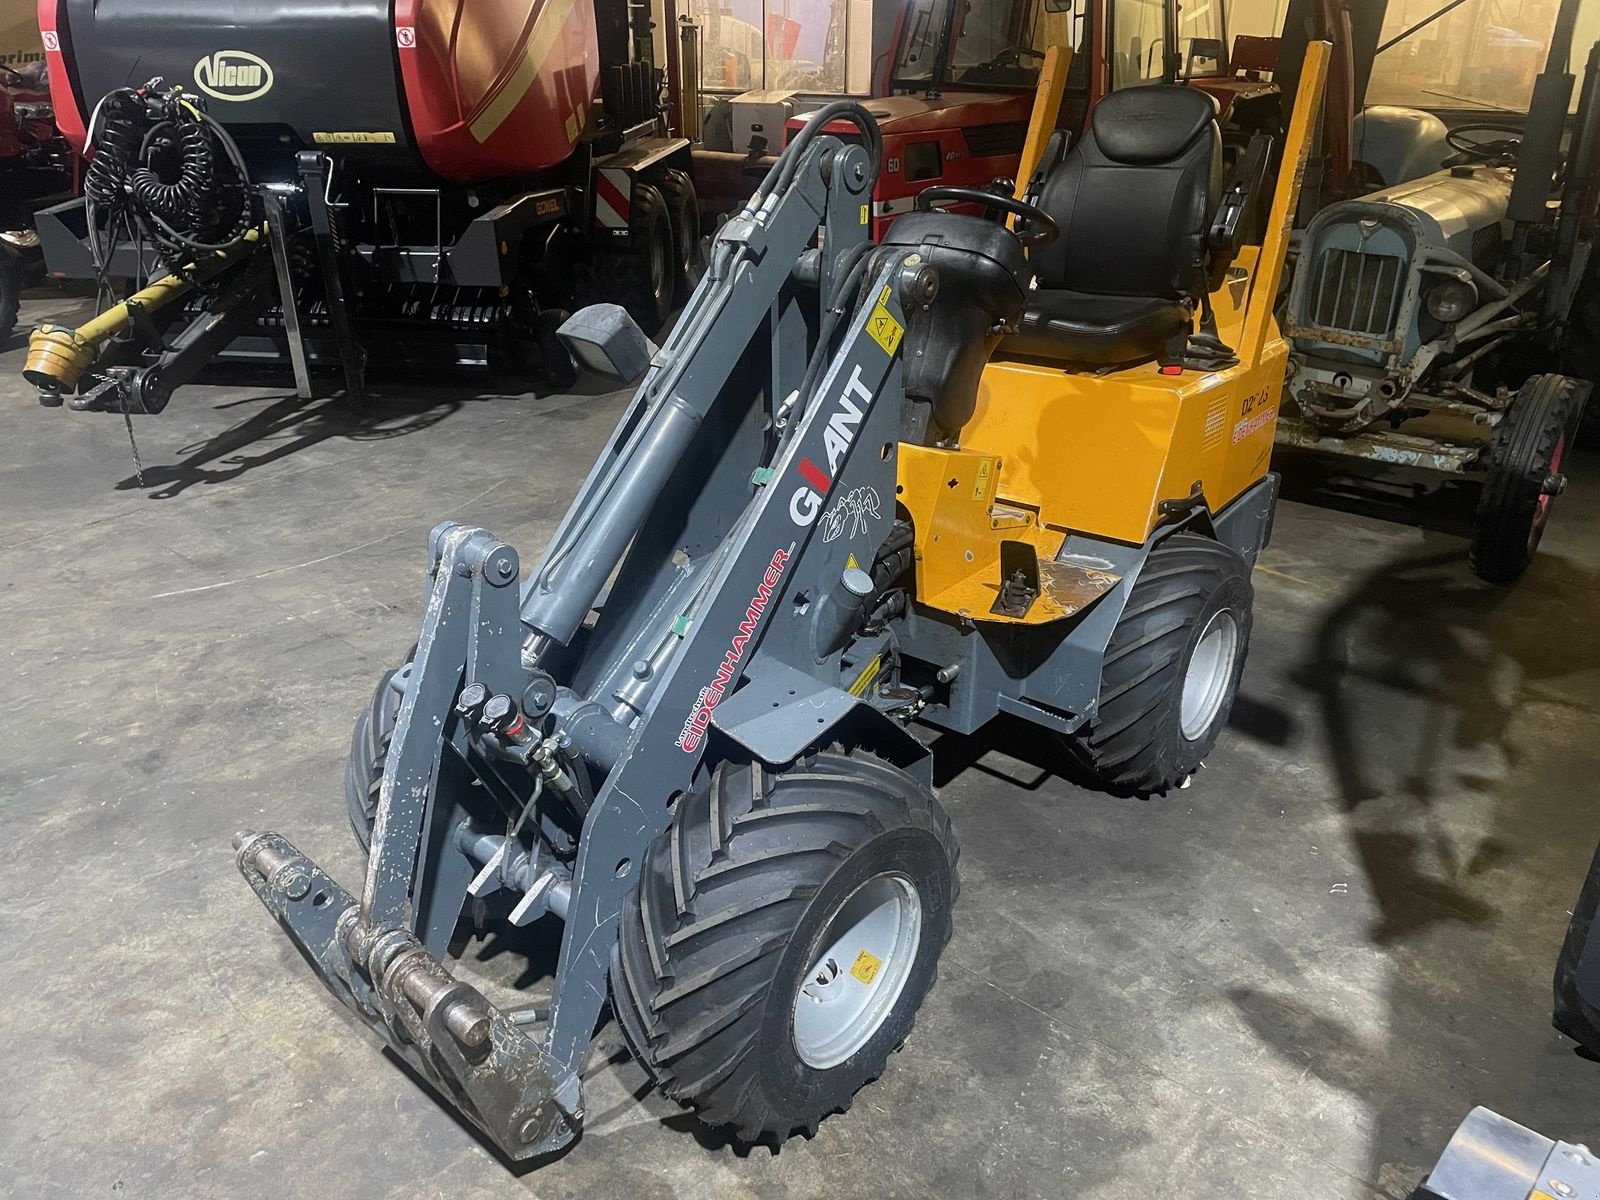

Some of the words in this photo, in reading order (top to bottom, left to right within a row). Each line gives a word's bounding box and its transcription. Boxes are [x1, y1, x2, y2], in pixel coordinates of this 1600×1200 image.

[200, 51, 264, 90] Vicon
[789, 364, 873, 527] GIANT
[681, 548, 790, 753] EIDENHAMMER
[674, 685, 709, 748] Landtechnik
